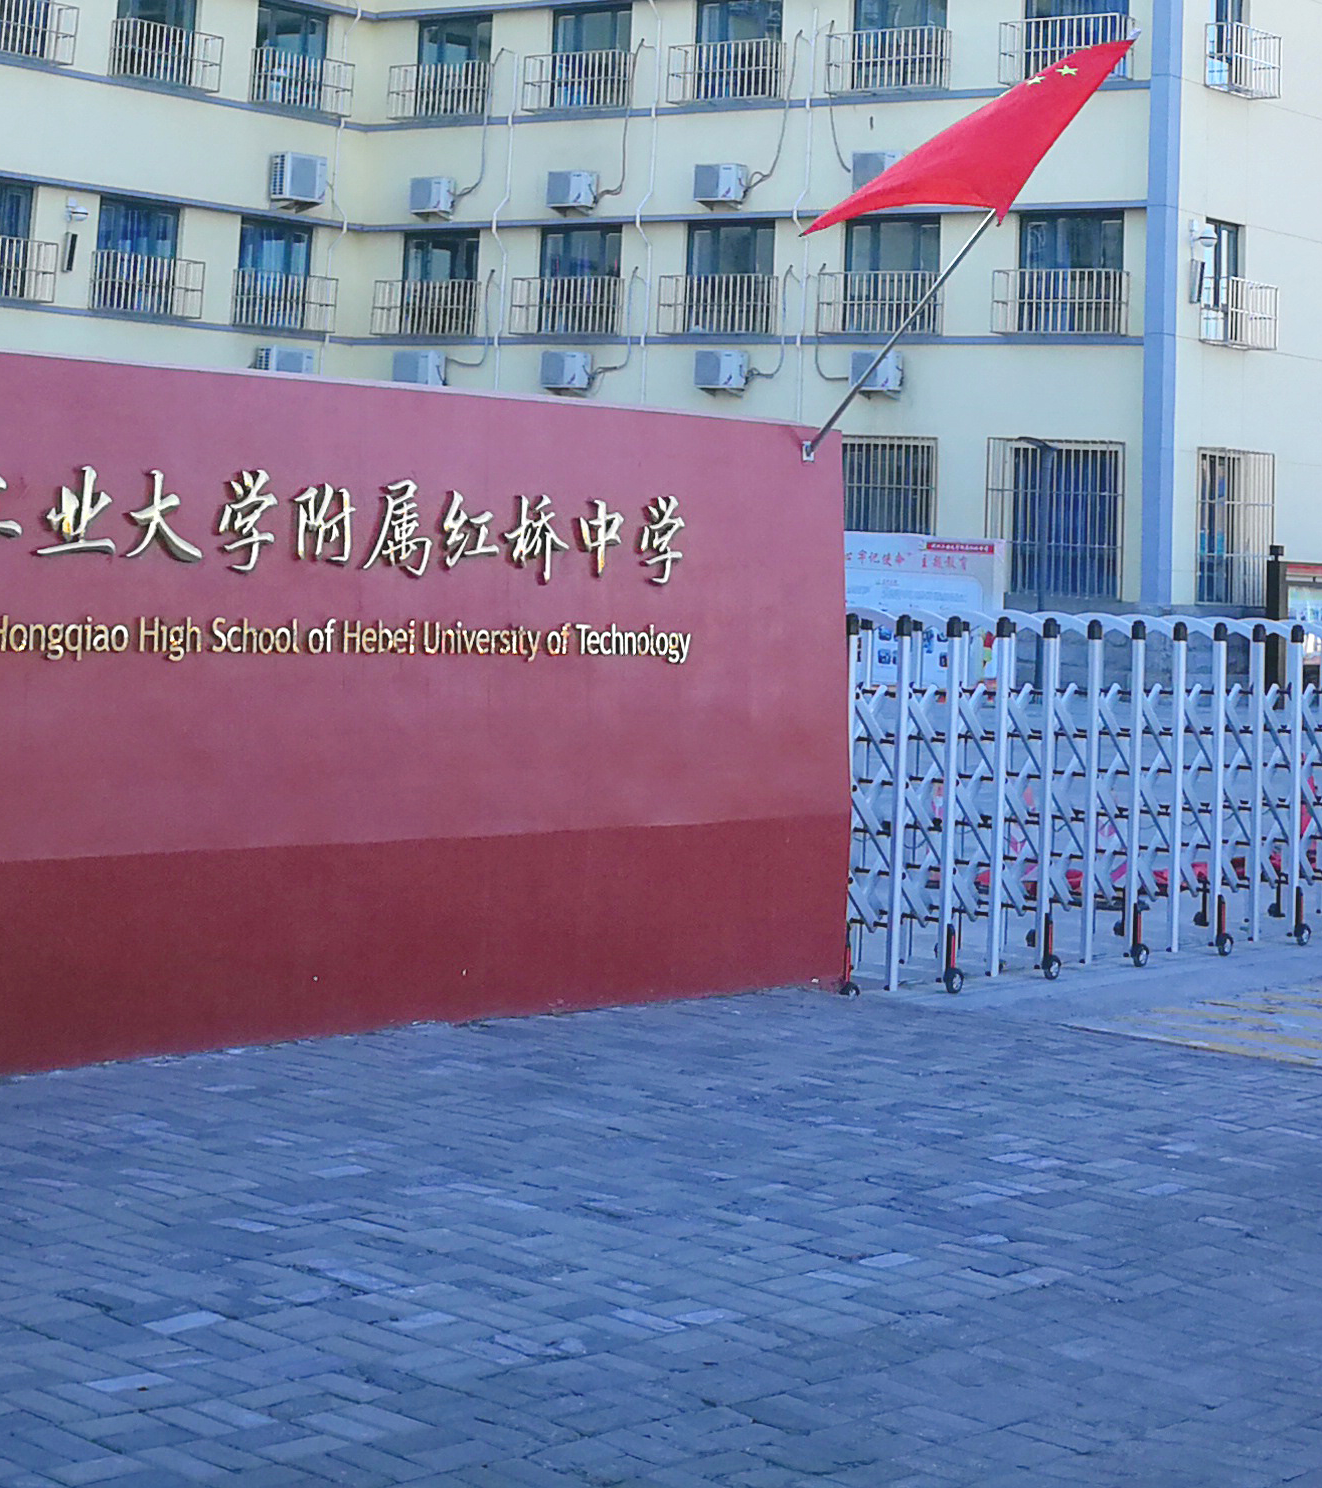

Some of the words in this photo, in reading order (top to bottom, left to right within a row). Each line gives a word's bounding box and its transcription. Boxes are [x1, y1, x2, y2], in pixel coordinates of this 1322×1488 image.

[140, 615, 202, 662] High
[211, 617, 299, 654] School
[308, 618, 337, 655] of
[343, 619, 416, 656] Hebei
[423, 621, 541, 662] University
[547, 622, 572, 657] of
[577, 624, 692, 664] Technology
